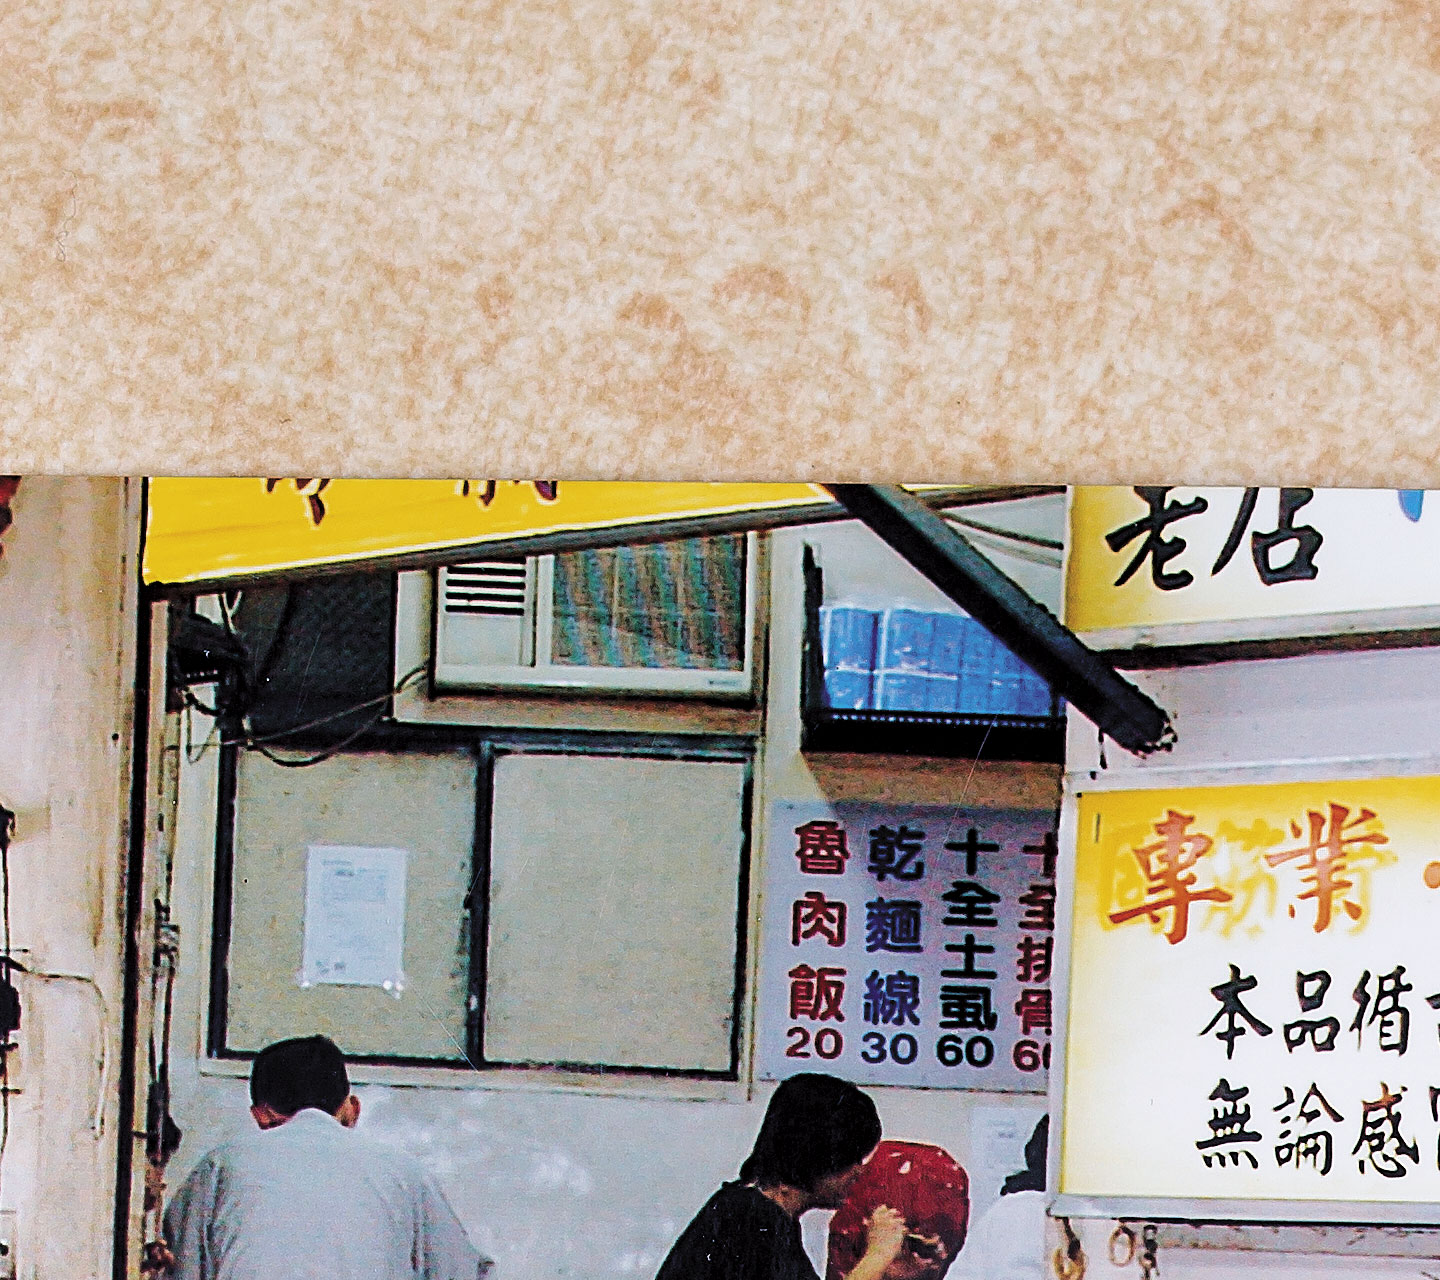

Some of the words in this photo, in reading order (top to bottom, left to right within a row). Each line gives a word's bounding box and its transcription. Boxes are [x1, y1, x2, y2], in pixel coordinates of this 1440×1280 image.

[1105, 486, 1324, 592] 老店
[787, 819, 850, 1023] 魯肉飯
[863, 823, 926, 1028] 乾麵線
[785, 1026, 845, 1060] 20
[861, 1031, 919, 1066] 30
[935, 1033, 995, 1069] 60
